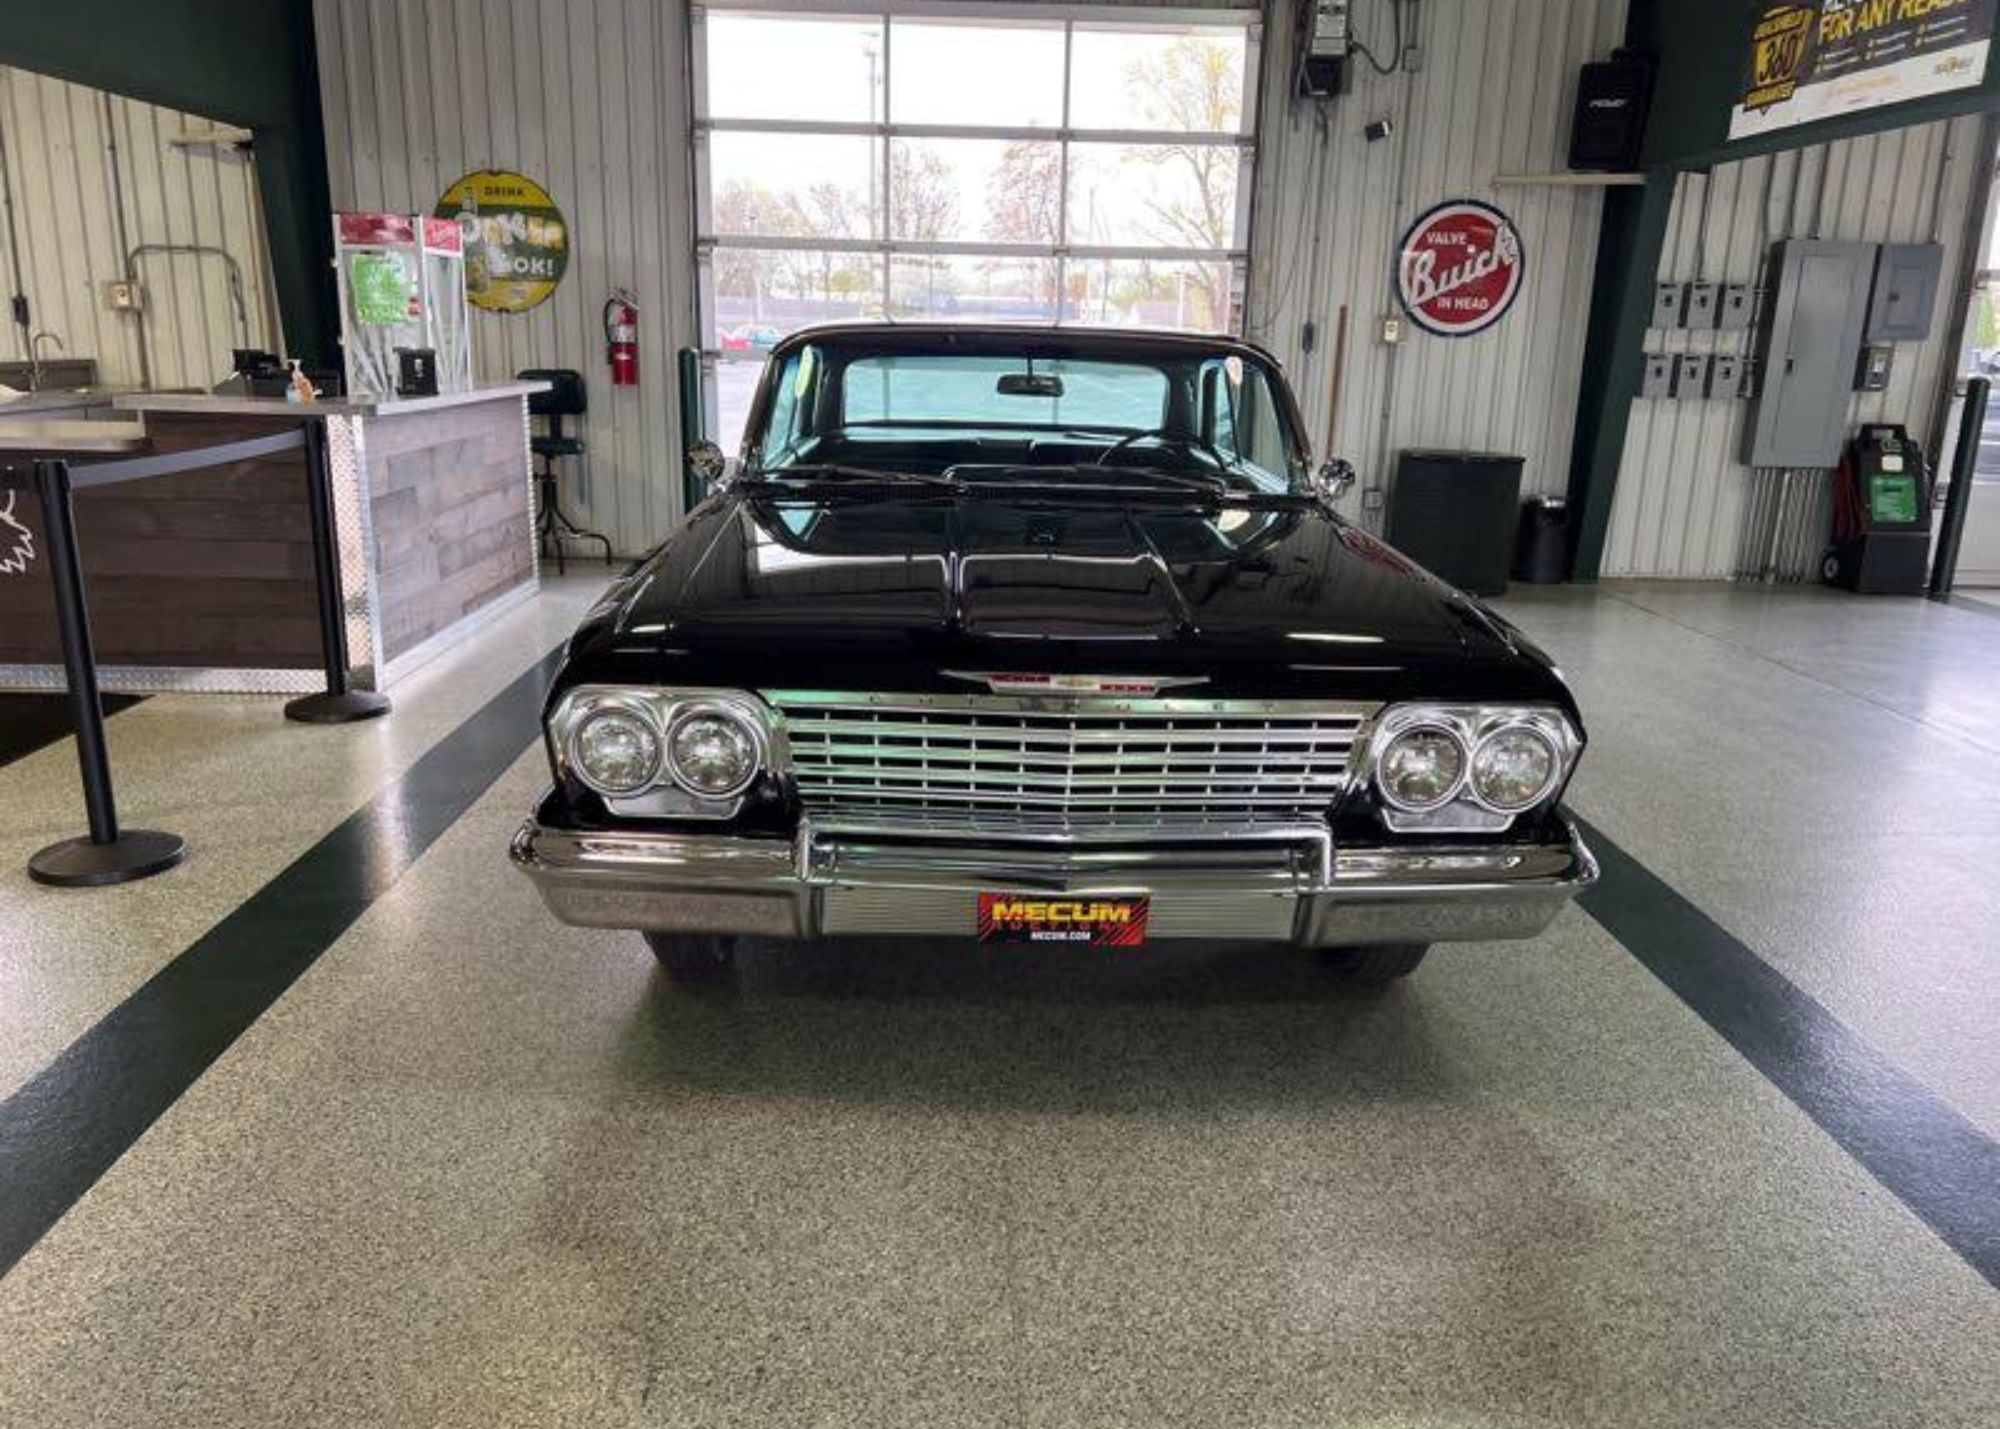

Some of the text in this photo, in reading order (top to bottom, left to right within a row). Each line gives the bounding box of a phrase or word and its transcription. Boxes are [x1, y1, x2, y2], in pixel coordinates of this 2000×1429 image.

[1817, 9, 1853, 45] FOR
[1854, 0, 1893, 32] ANY
[1426, 231, 1468, 245] VALVE
[1401, 219, 1518, 307] Buick
[1436, 297, 1490, 310] IN HEAD
[992, 901, 1131, 922] MECUM
[1030, 931, 1091, 940] MECUM.COM
